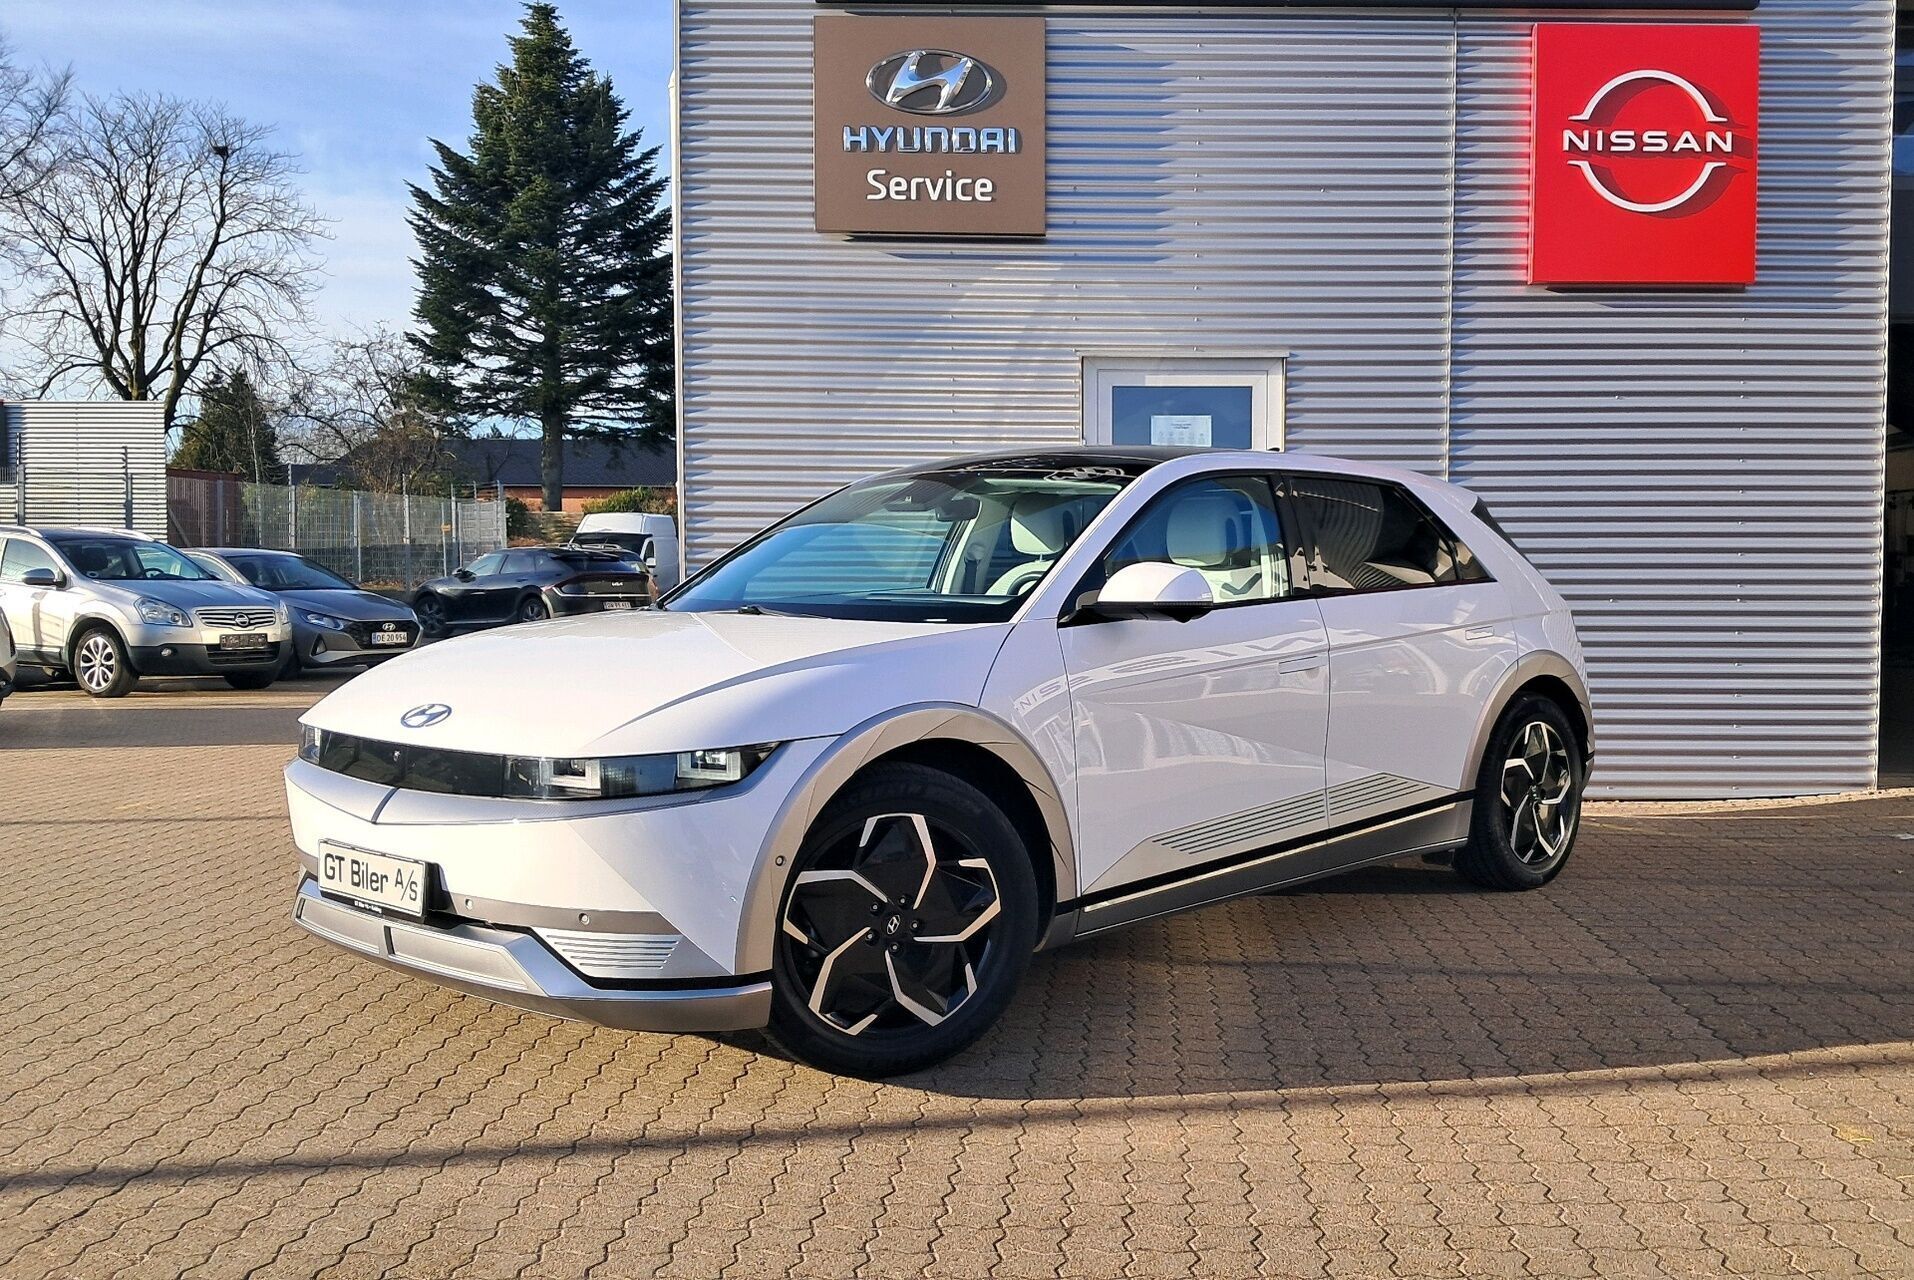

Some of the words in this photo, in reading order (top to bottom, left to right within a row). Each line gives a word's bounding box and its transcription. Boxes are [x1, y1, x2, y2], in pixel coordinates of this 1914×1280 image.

[842, 126, 1016, 153] HYUNDAI
[1562, 129, 1733, 153] NISSAN
[866, 169, 993, 201] Service
[324, 853, 345, 882] GT
[351, 859, 388, 893] Biler
[394, 868, 418, 901] A/S
